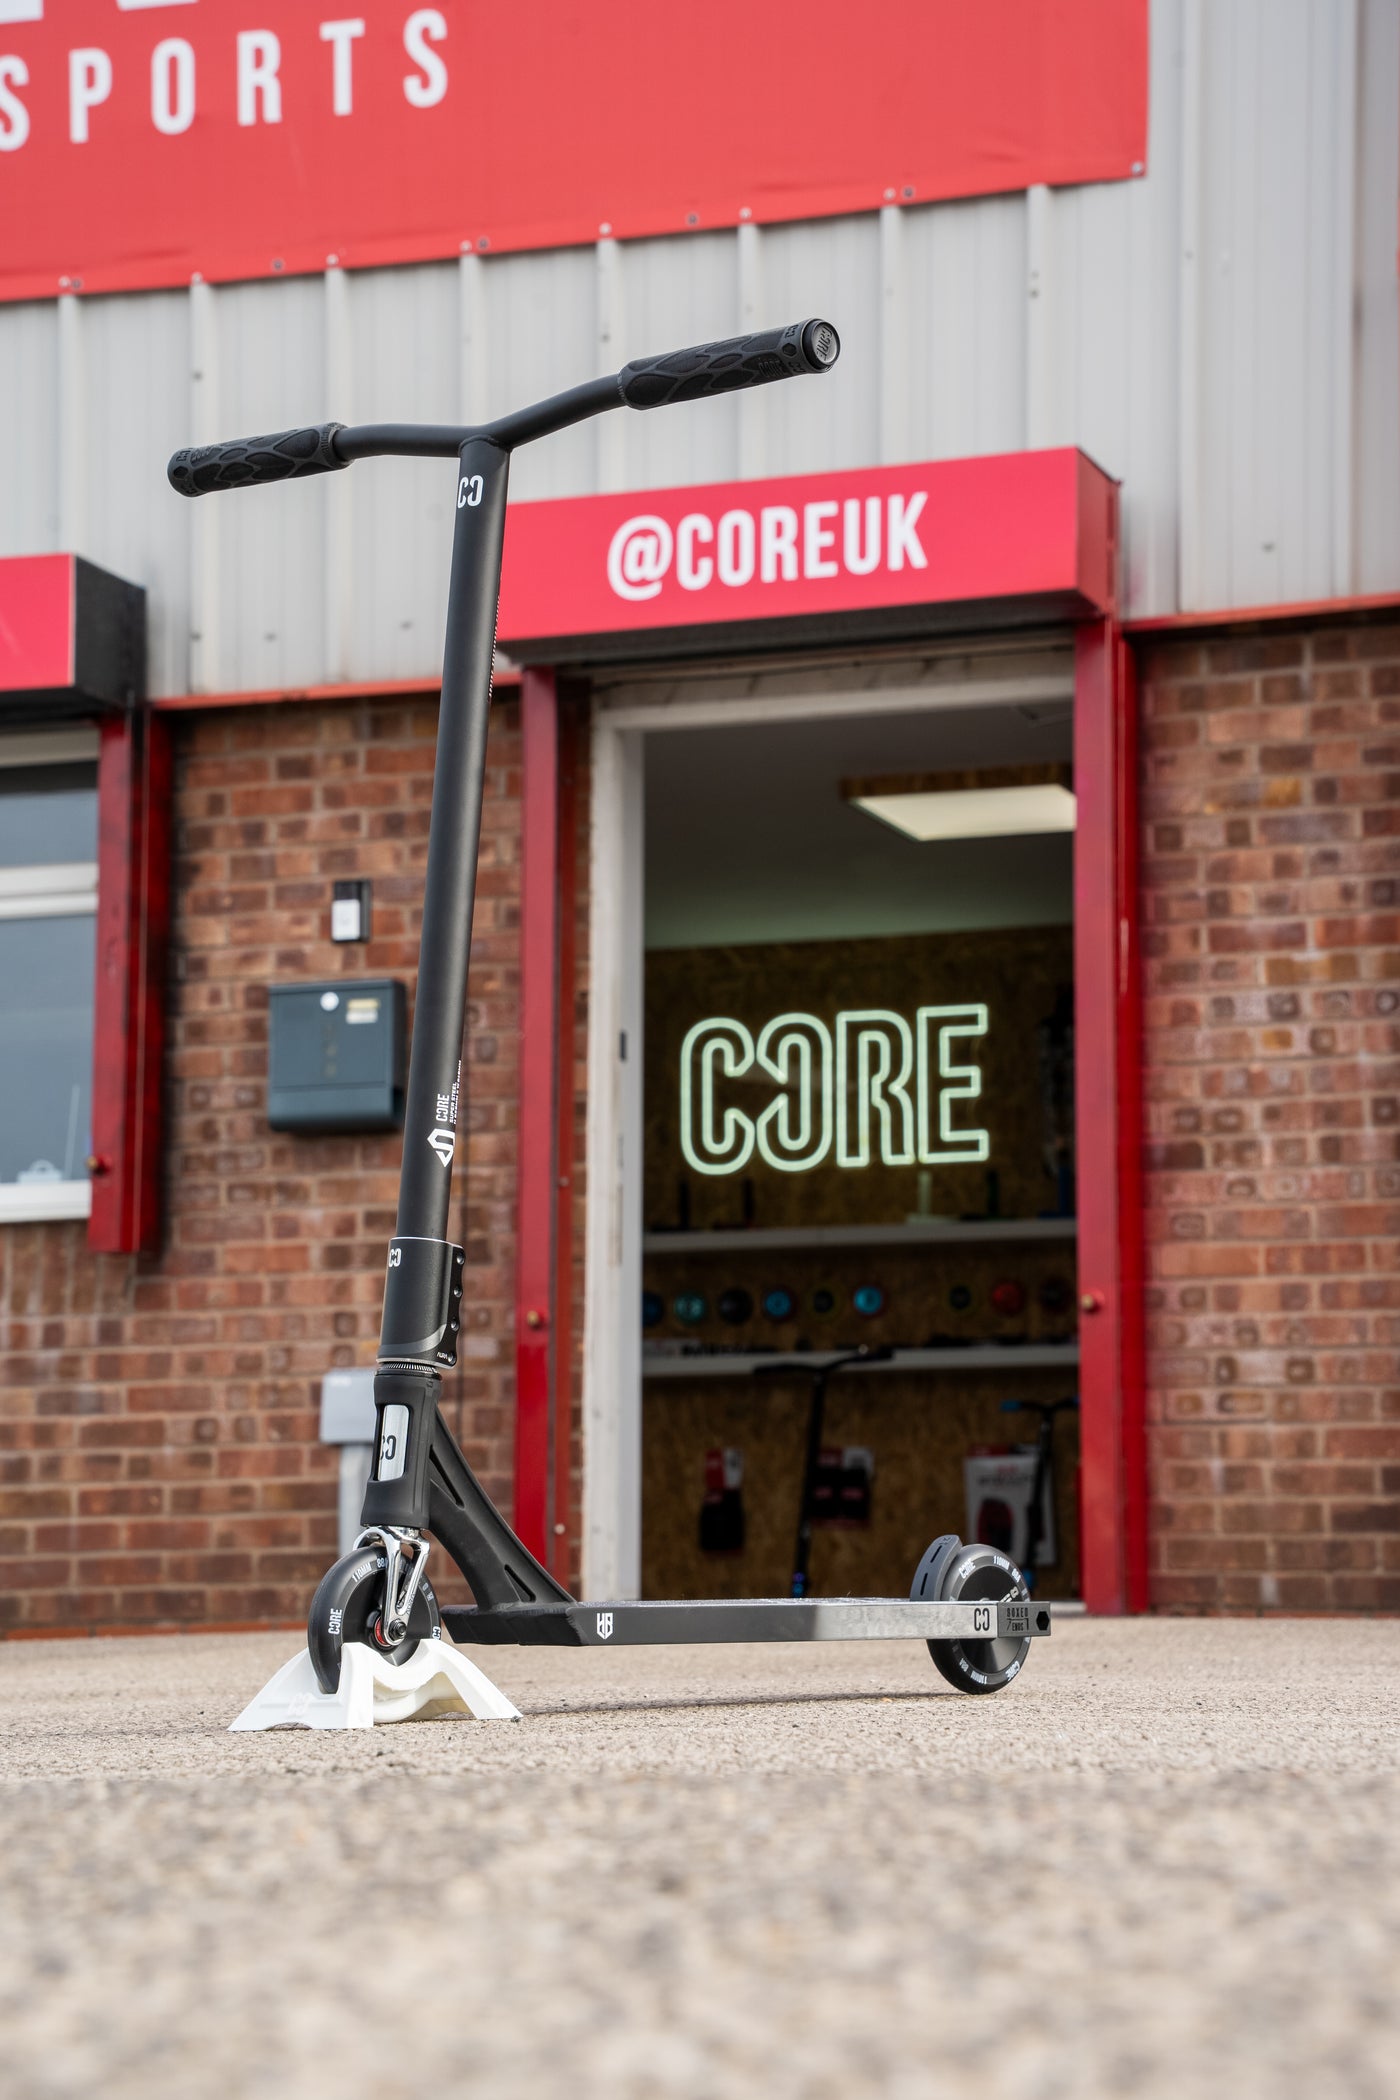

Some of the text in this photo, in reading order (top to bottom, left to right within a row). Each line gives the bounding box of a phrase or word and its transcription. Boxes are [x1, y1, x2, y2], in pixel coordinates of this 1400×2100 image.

[0, 9, 447, 152] SPORTS
[606, 491, 928, 600] @COREUK
[435, 1093, 449, 1122] CORE
[680, 1003, 990, 1175] CORE
[327, 1608, 343, 1635] CORE
